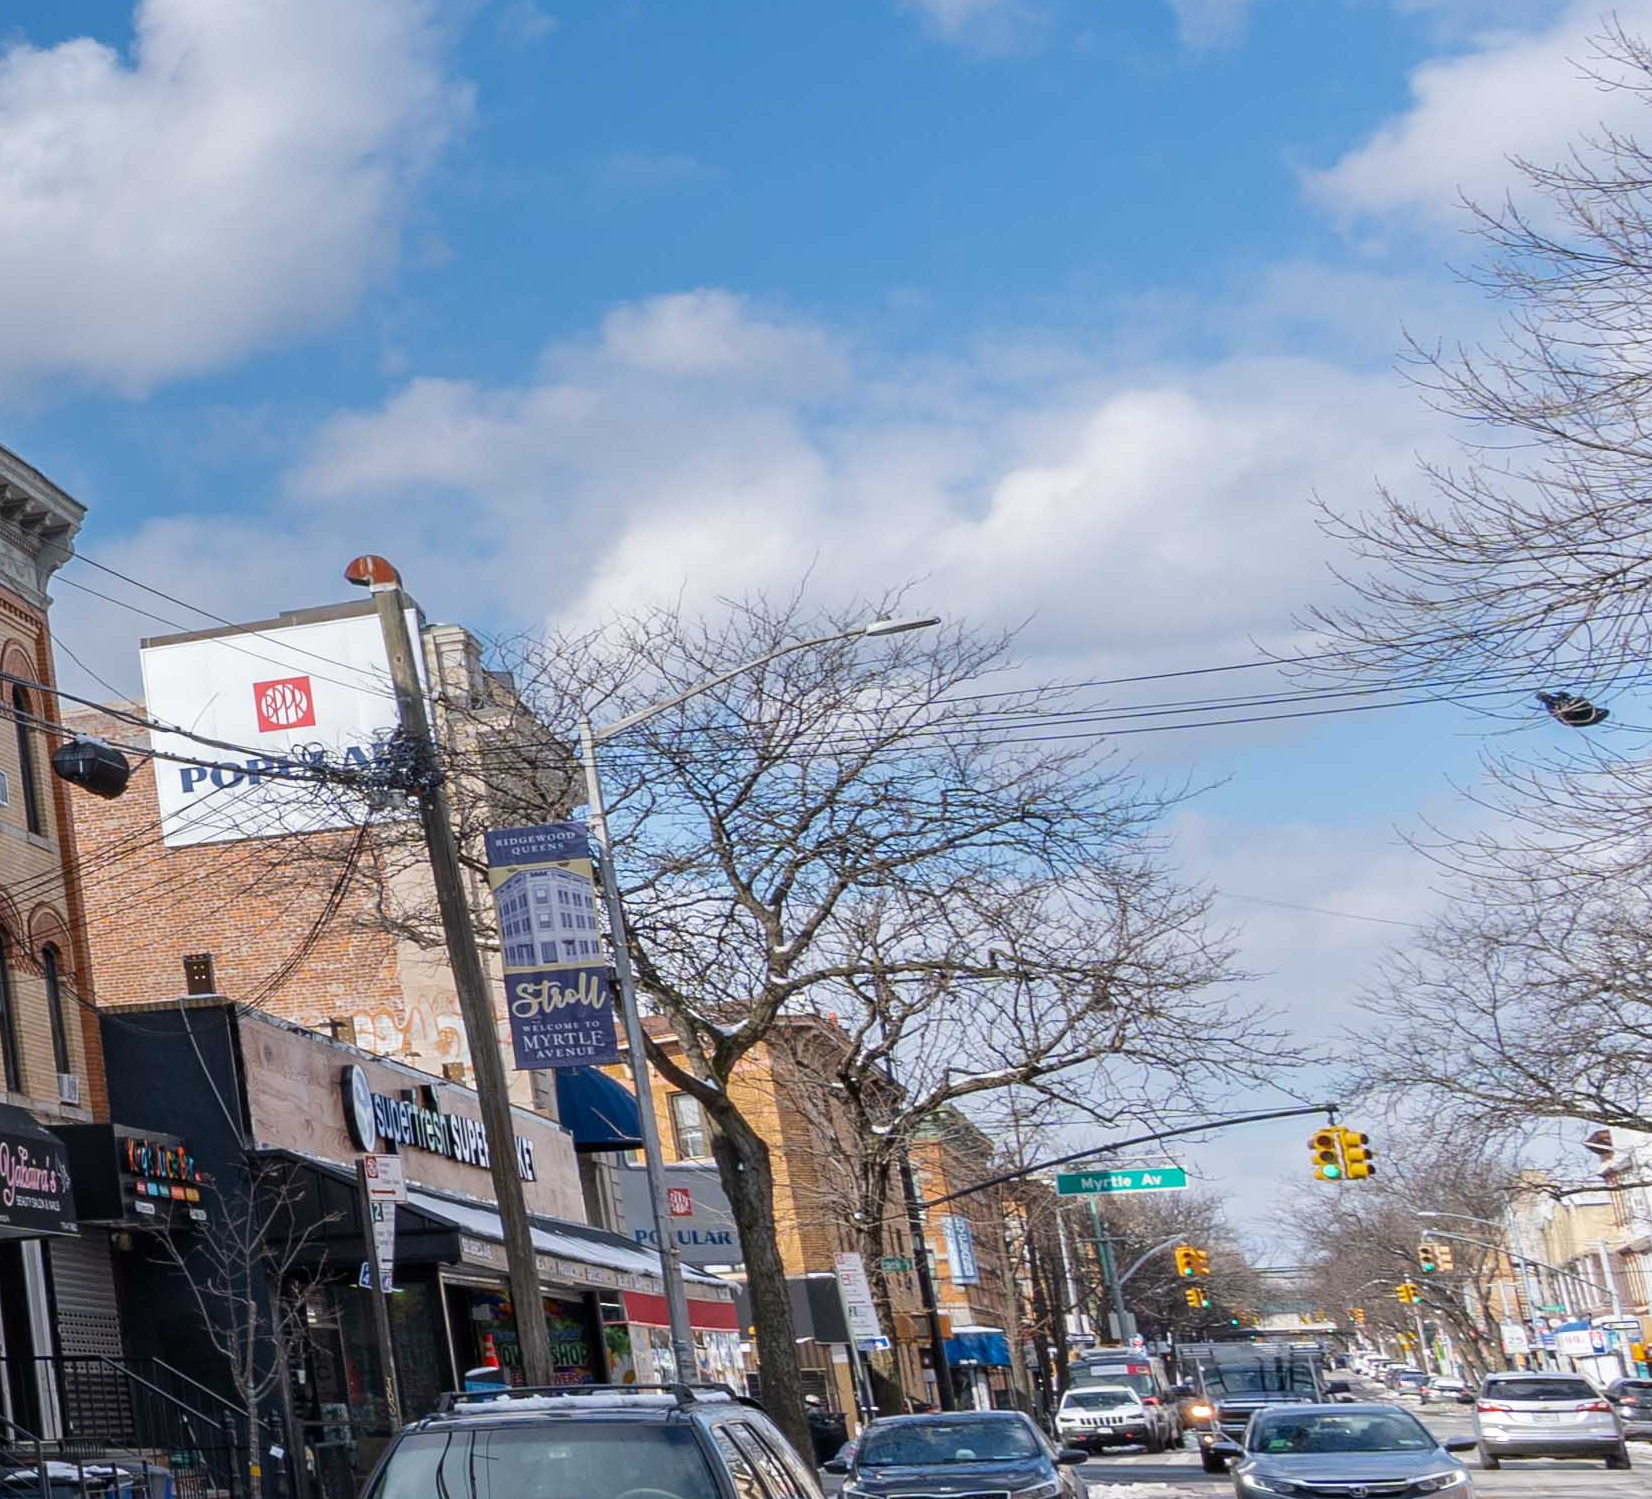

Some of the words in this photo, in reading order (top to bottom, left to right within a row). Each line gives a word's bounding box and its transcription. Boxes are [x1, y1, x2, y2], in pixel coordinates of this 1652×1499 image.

[495, 831, 576, 848] RIDGEWOOD
[511, 841, 565, 855] QUEENS
[512, 972, 607, 1018] Stroll
[522, 1022, 579, 1032] WELCOME
[584, 1019, 601, 1029] TO
[523, 1030, 606, 1053] MYRTLE
[535, 1045, 596, 1060] AVENUE
[1081, 1176, 1132, 1190] Myrtle
[1142, 1173, 1162, 1187] Av
[634, 1230, 732, 1245] POULAR
